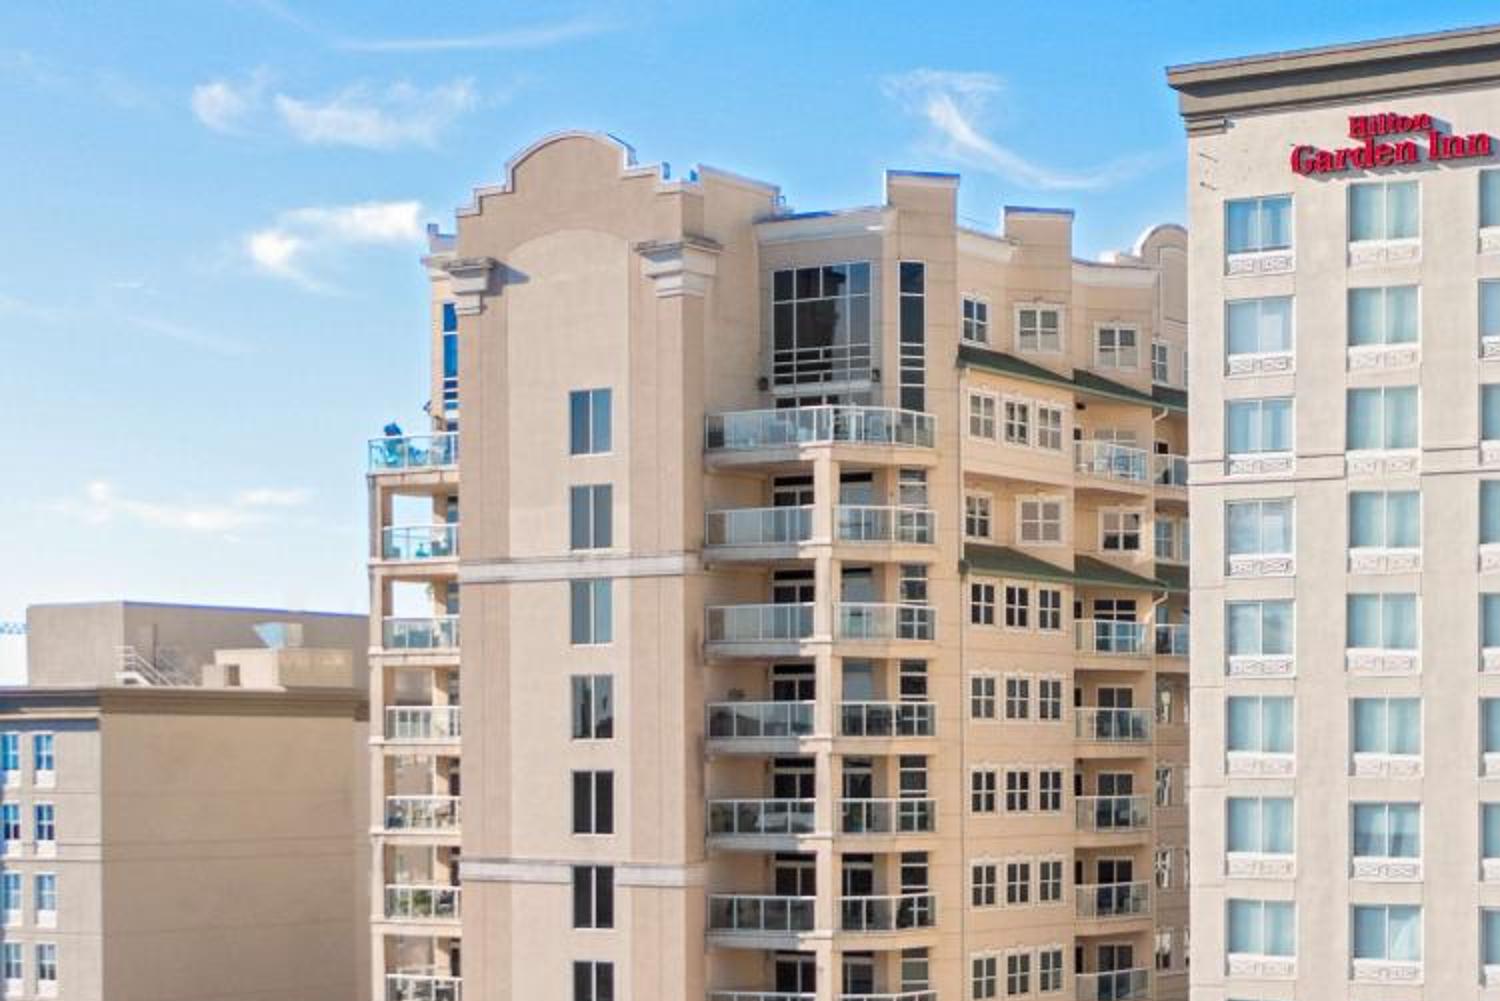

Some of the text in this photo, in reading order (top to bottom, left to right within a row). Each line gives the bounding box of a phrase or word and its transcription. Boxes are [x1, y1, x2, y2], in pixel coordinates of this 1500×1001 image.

[1349, 112, 1432, 138] Hilton
[1290, 130, 1492, 175] Garden Inn
